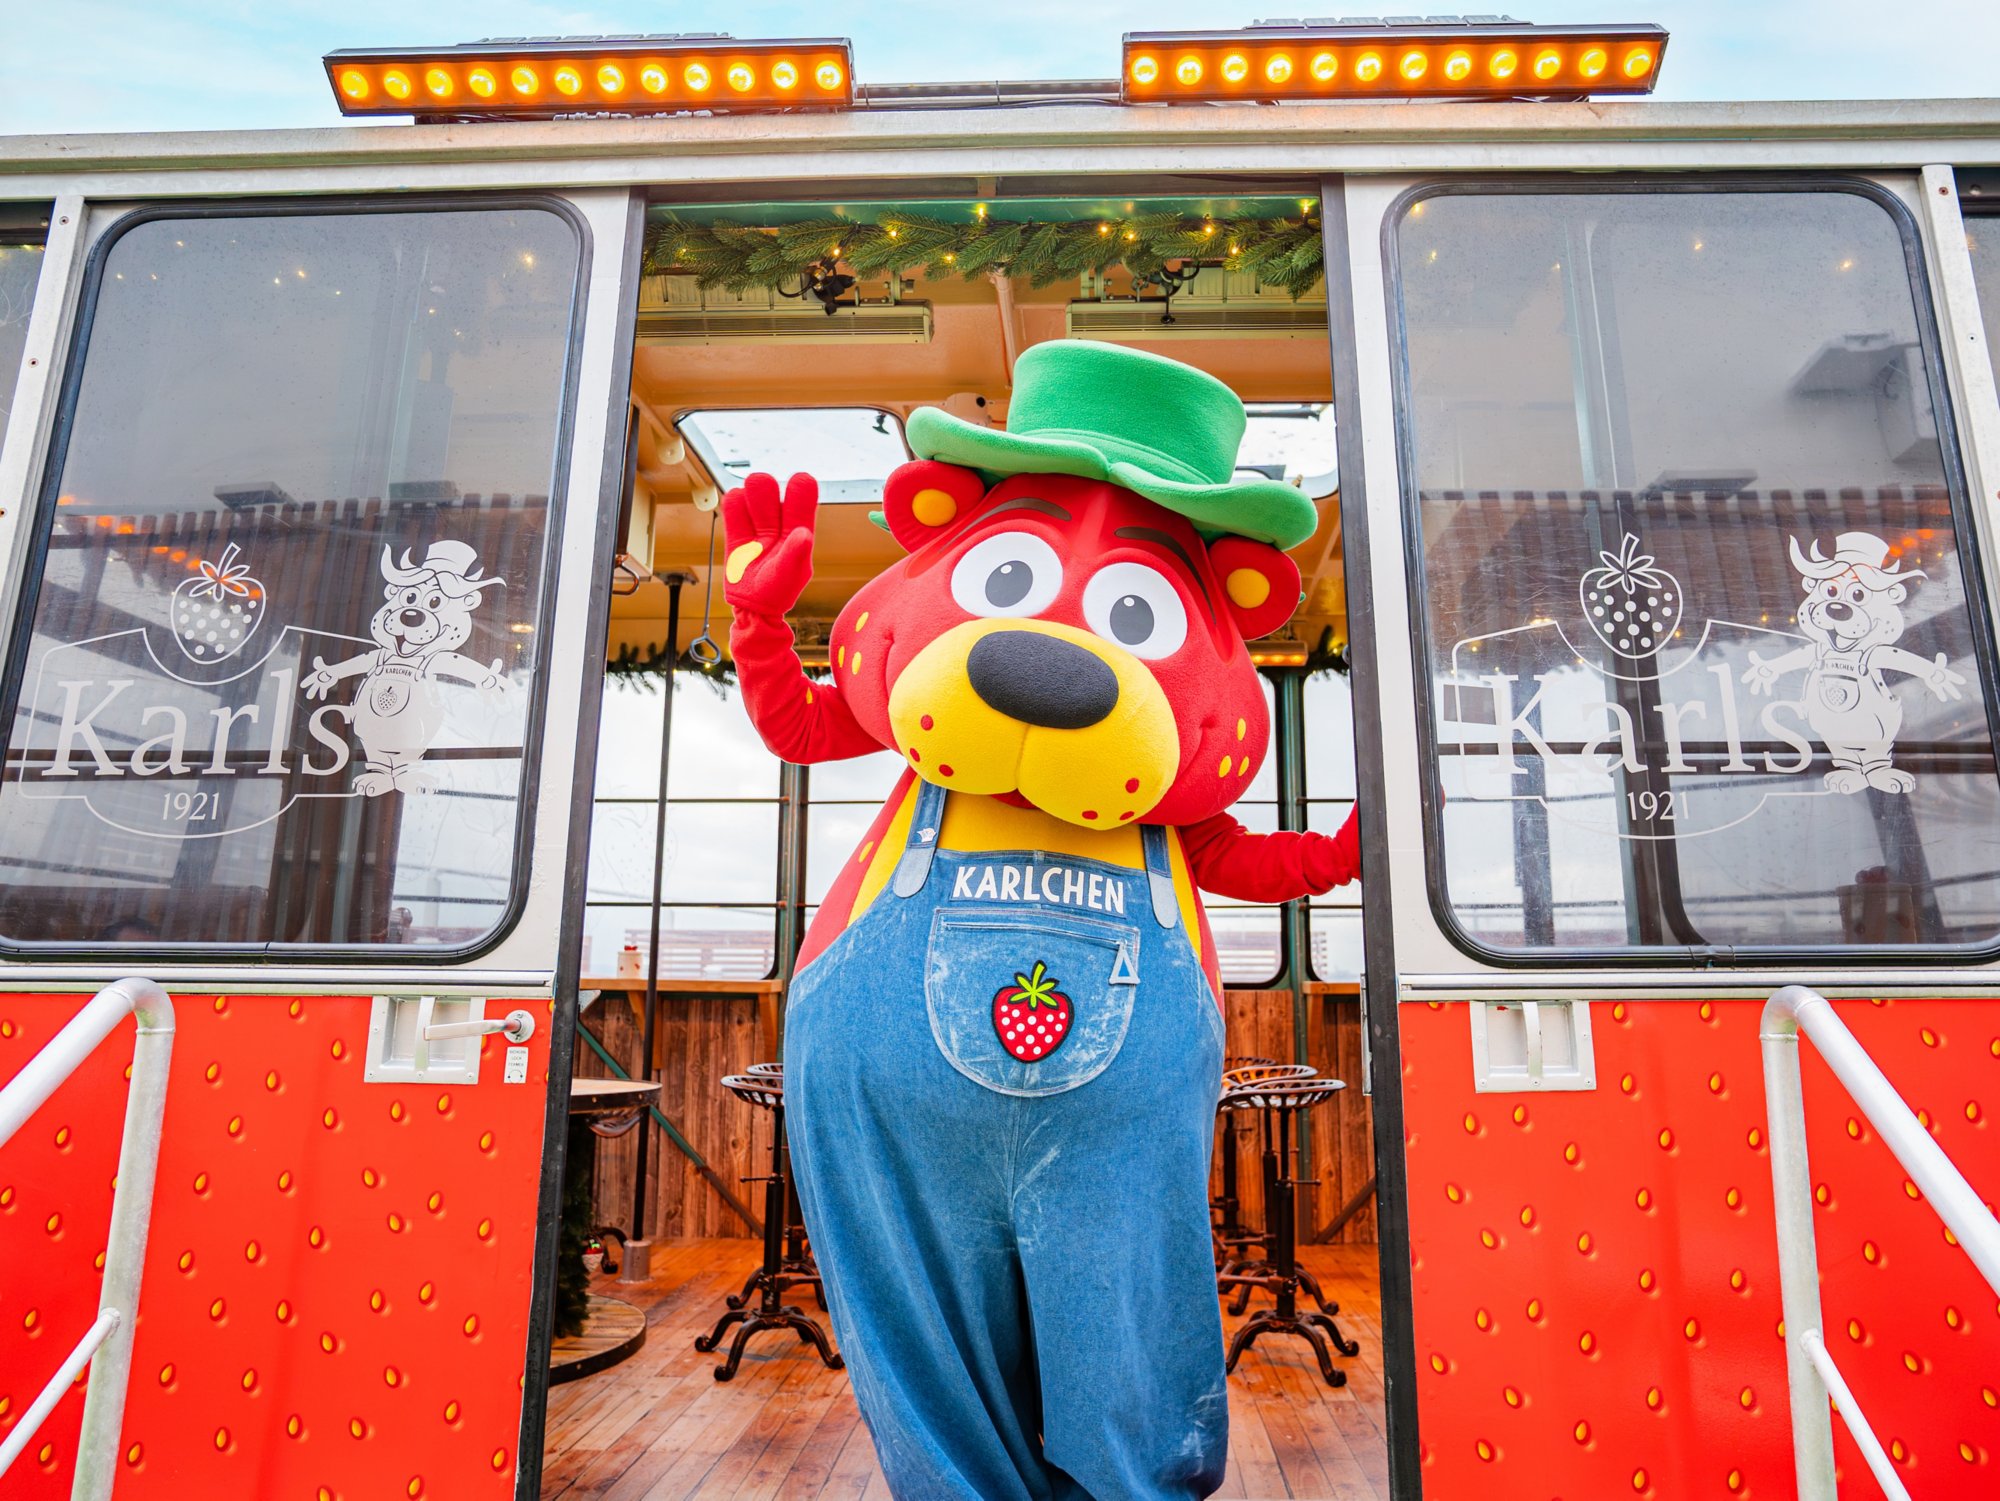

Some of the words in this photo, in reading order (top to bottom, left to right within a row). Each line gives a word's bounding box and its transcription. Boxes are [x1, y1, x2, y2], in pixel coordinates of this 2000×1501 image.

[41, 668, 351, 776] Karls
[1480, 662, 1813, 774] Karls
[162, 791, 220, 821] 1921
[1627, 791, 1689, 821] 1921
[952, 865, 1125, 915] KARLCHEN
